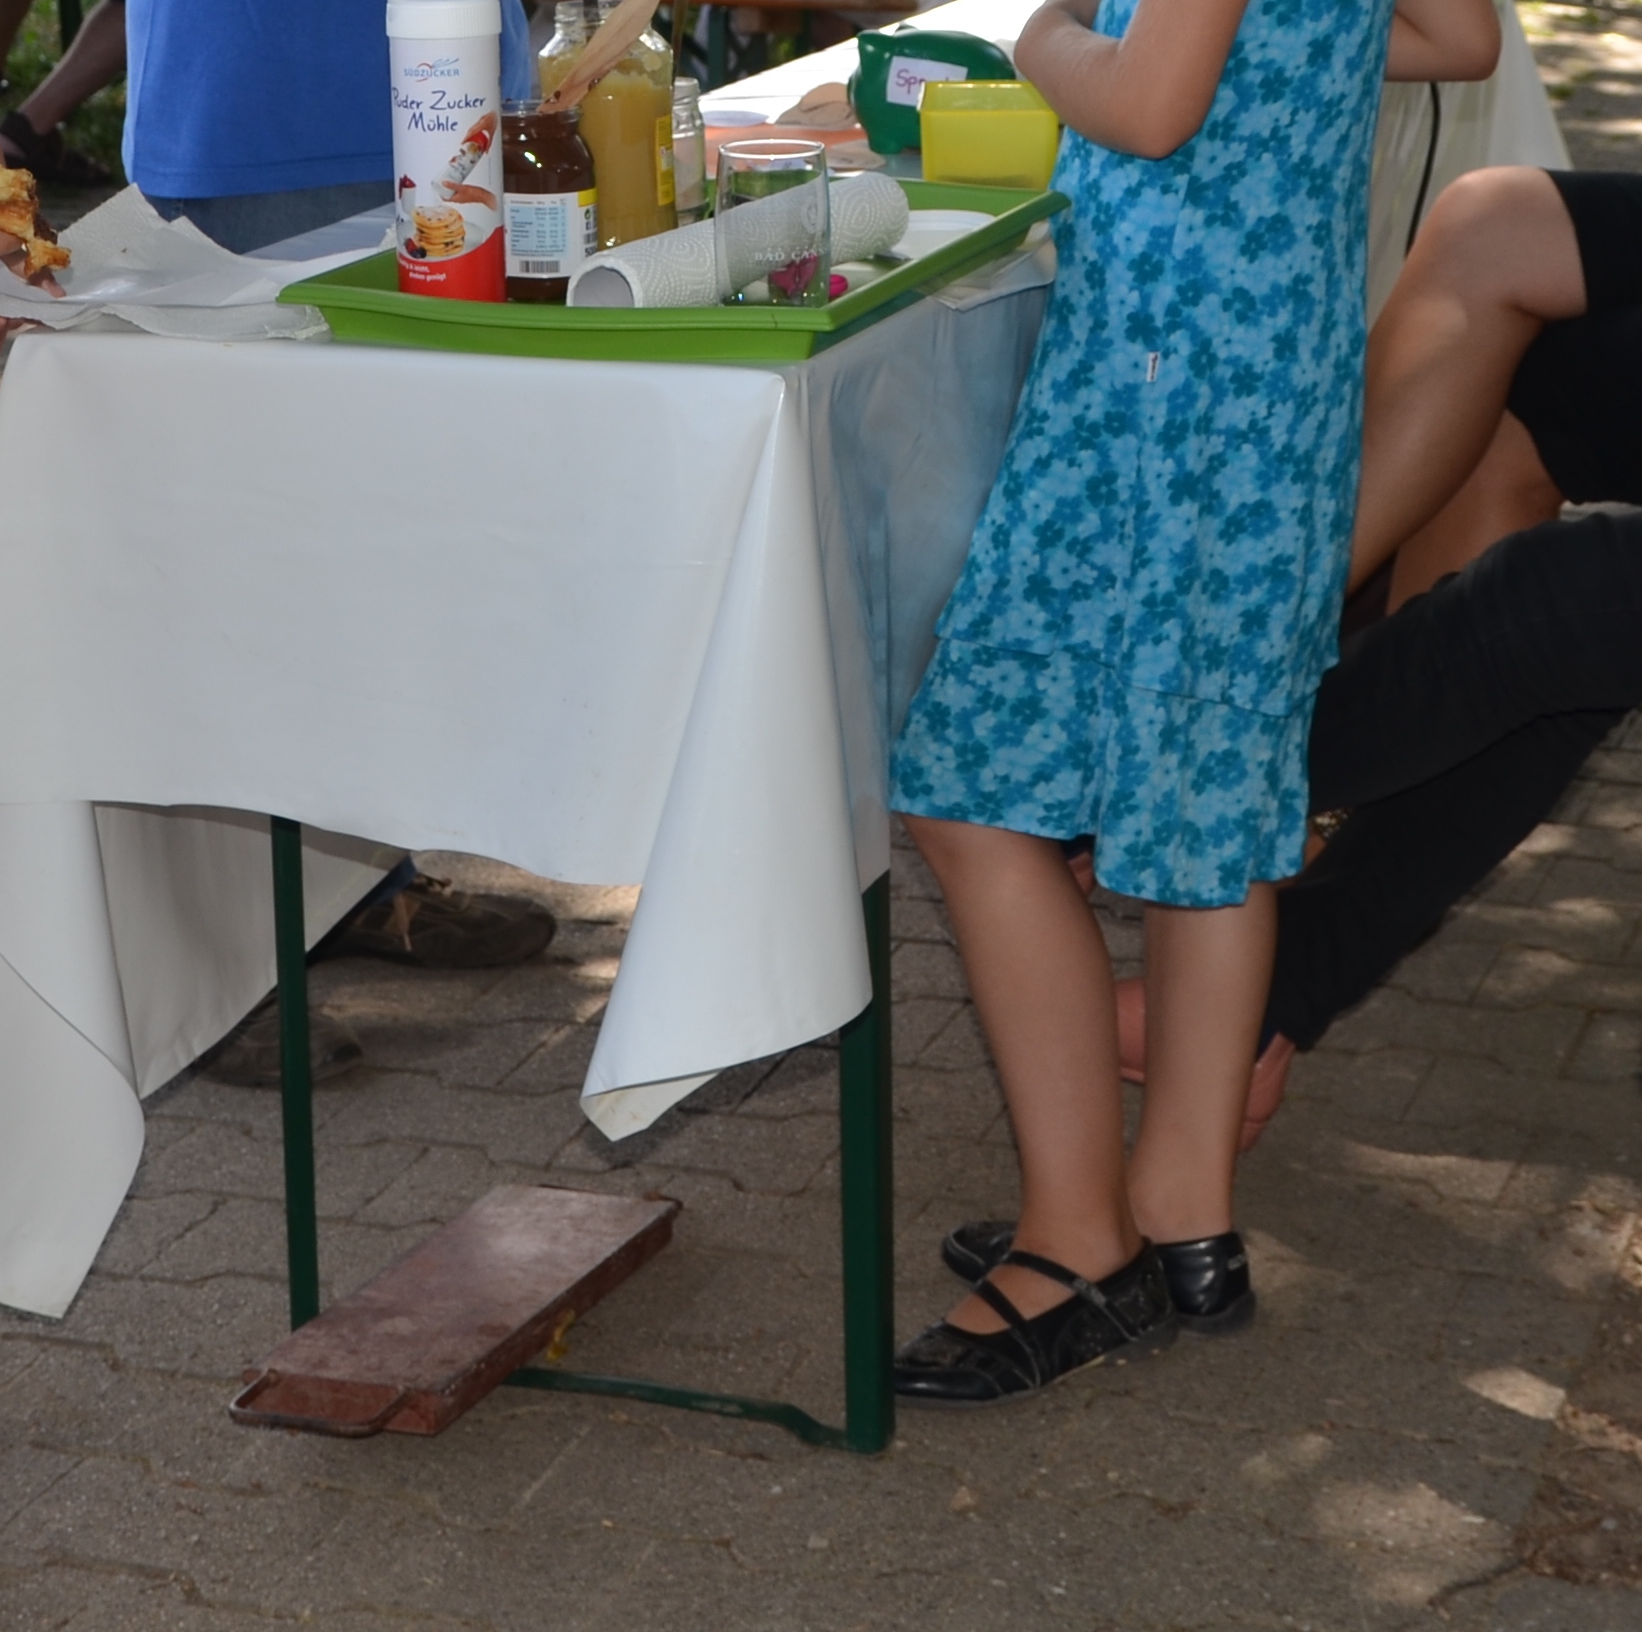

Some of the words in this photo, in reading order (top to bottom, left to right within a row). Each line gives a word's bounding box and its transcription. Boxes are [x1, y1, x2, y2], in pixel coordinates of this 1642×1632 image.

[403, 67, 460, 78] SÜDZUCKER
[392, 86, 423, 109] Puder
[429, 90, 486, 111] Zucker
[407, 111, 458, 133] Mühle
